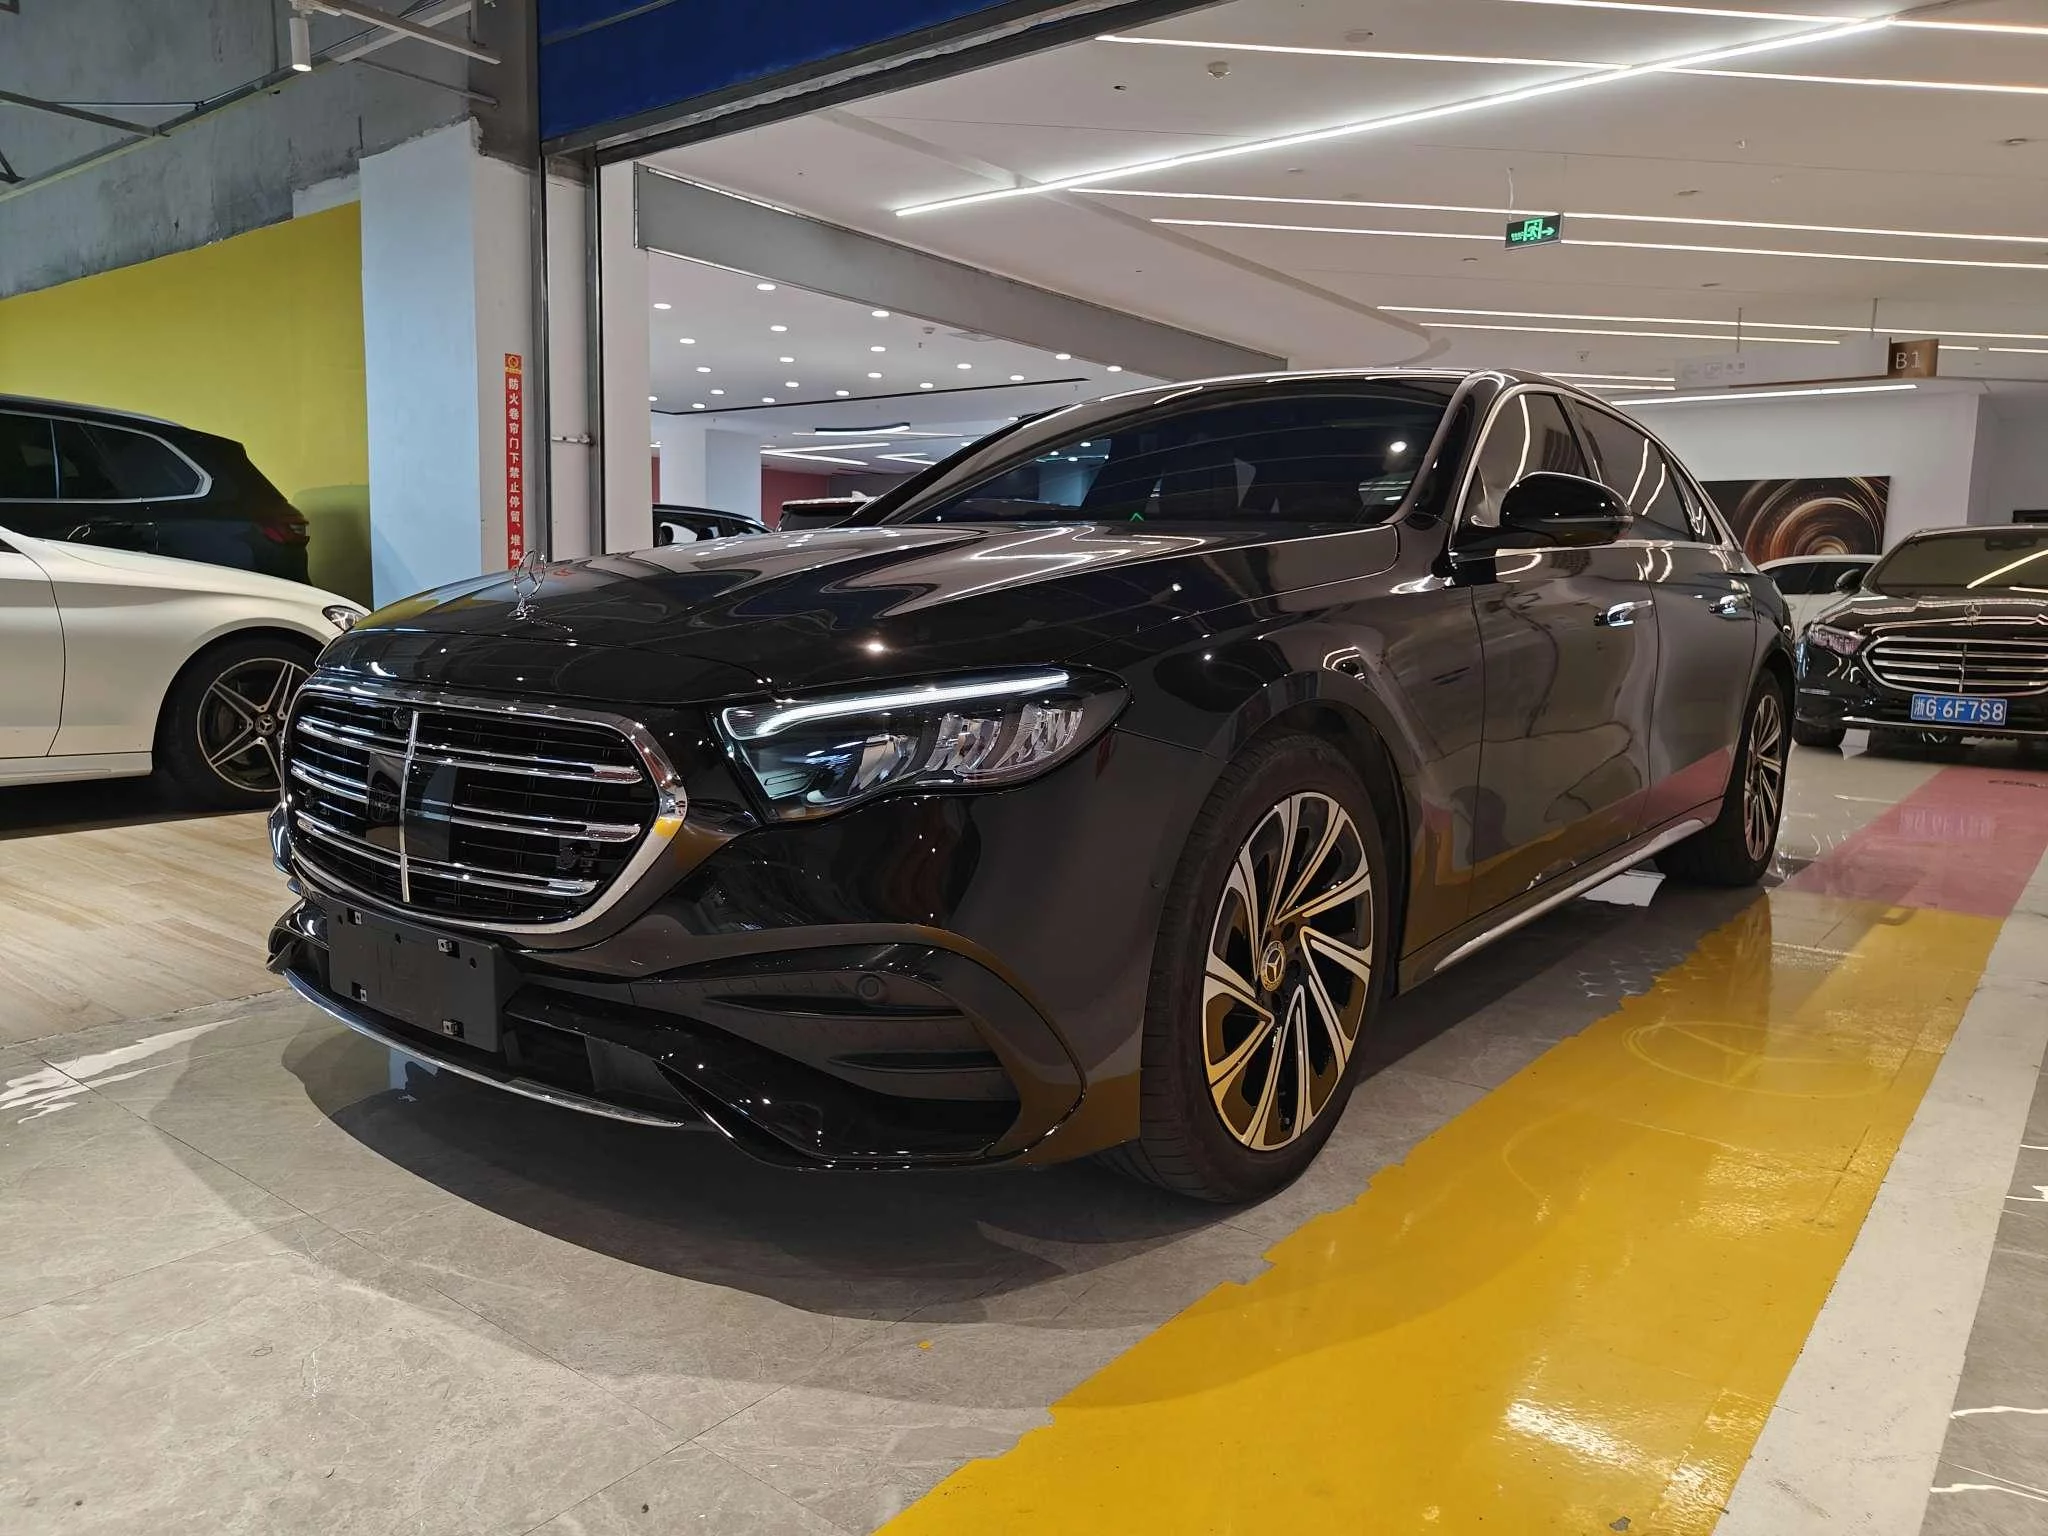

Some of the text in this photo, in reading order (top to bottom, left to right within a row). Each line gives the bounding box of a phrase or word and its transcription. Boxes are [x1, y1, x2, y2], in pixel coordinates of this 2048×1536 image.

[1895, 351, 1920, 370] B1
[508, 378, 521, 569] 防火卷帘门下禁止停留、堆放
